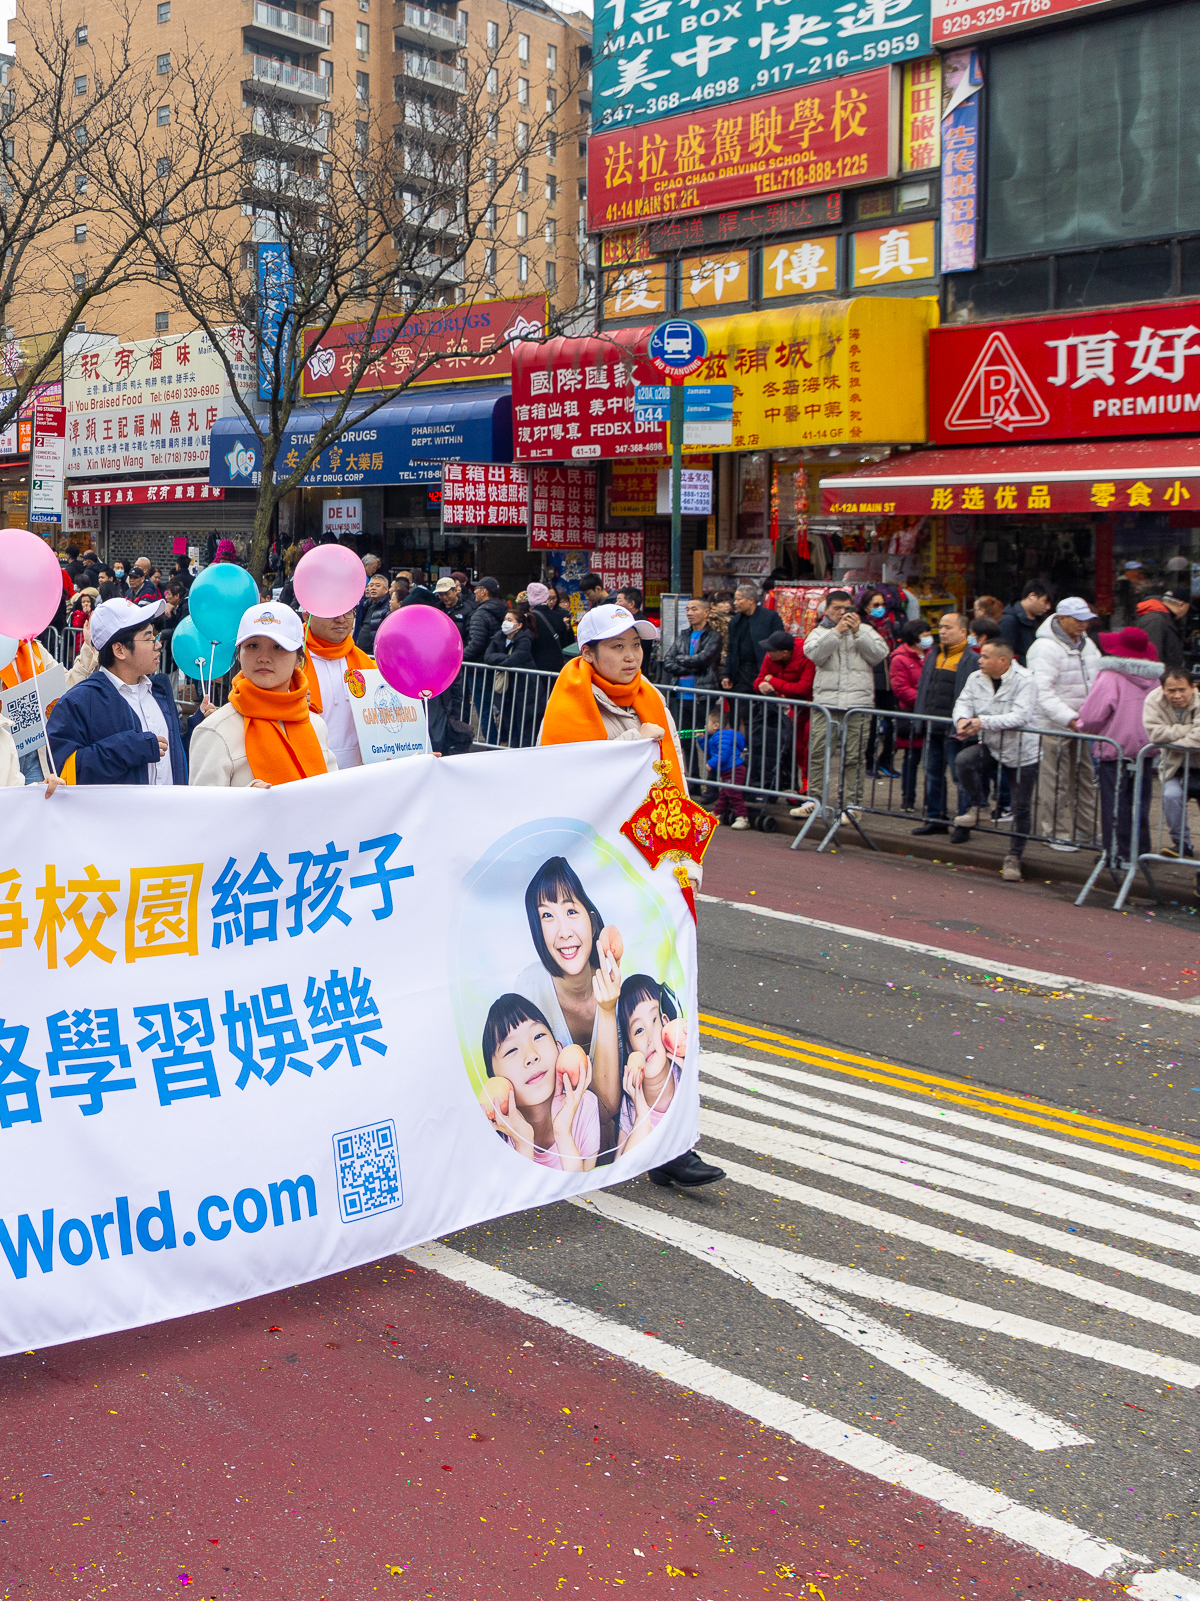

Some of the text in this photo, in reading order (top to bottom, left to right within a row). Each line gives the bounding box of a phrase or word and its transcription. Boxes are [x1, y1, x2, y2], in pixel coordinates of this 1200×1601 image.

[603, 25, 670, 54] MAIL
[681, 1, 743, 33] BOX
[602, 76, 740, 125] 347-368-4698
[910, 60, 937, 170] 旺旺旅游
[604, 87, 869, 189] 法拉盛駕駛學校
[654, 150, 818, 192] CHAO CHAO DRIVING SCHOOL
[754, 153, 869, 193] TEL:718-888-1225
[943, 101, 977, 245] 告传媒招牌
[606, 203, 633, 221] 41-14
[634, 195, 661, 215] MAIN
[429, 313, 491, 337] DRUGS
[653, 358, 702, 376] NO STANDING
[67, 402, 74, 412] Ji
[75, 399, 89, 411] You
[90, 394, 120, 409] Braised
[122, 392, 143, 405] Food
[164, 388, 182, 402] (646)
[183, 384, 220, 399] 339-6905
[515, 400, 580, 421] 信箱出租
[637, 408, 664, 421] Q44
[341, 430, 378, 442] DRUGS
[412, 424, 456, 436] PHARMACY
[590, 420, 662, 437] FEDEX DHL
[802, 428, 844, 440] 41-14 GF
[37, 438, 42, 447] 2
[412, 434, 464, 447] DEPT. WITHIN
[575, 447, 597, 455] 41-14
[67, 462, 80, 471] 41-18
[87, 459, 98, 470] Xin
[100, 457, 121, 471] Wang
[122, 455, 144, 469] Wang
[164, 452, 182, 464] (718)
[322, 474, 343, 482] DRUG
[344, 473, 364, 481] CORP
[399, 471, 417, 480] TEL:
[444, 463, 529, 484] 信箱出租
[533, 469, 596, 485] 收人民币
[34, 480, 40, 490] 2
[443, 482, 529, 502] 国际快递 快速照相
[534, 485, 596, 499] 信箱出租
[533, 499, 596, 514] 翻译设计
[930, 484, 1051, 511] 彤选优品
[328, 507, 357, 519] DE LI
[443, 504, 529, 524] 翻译设计 复印传真
[830, 502, 897, 513] 41-12A MAIN ST
[533, 513, 596, 529] 国际快递
[533, 528, 596, 543] 快速照相
[590, 551, 644, 569] 信箱出租
[597, 572, 643, 590] 际快递
[362, 707, 379, 725] GAN
[394, 706, 417, 723] WORLD
[371, 742, 423, 754] GanJing World.com
